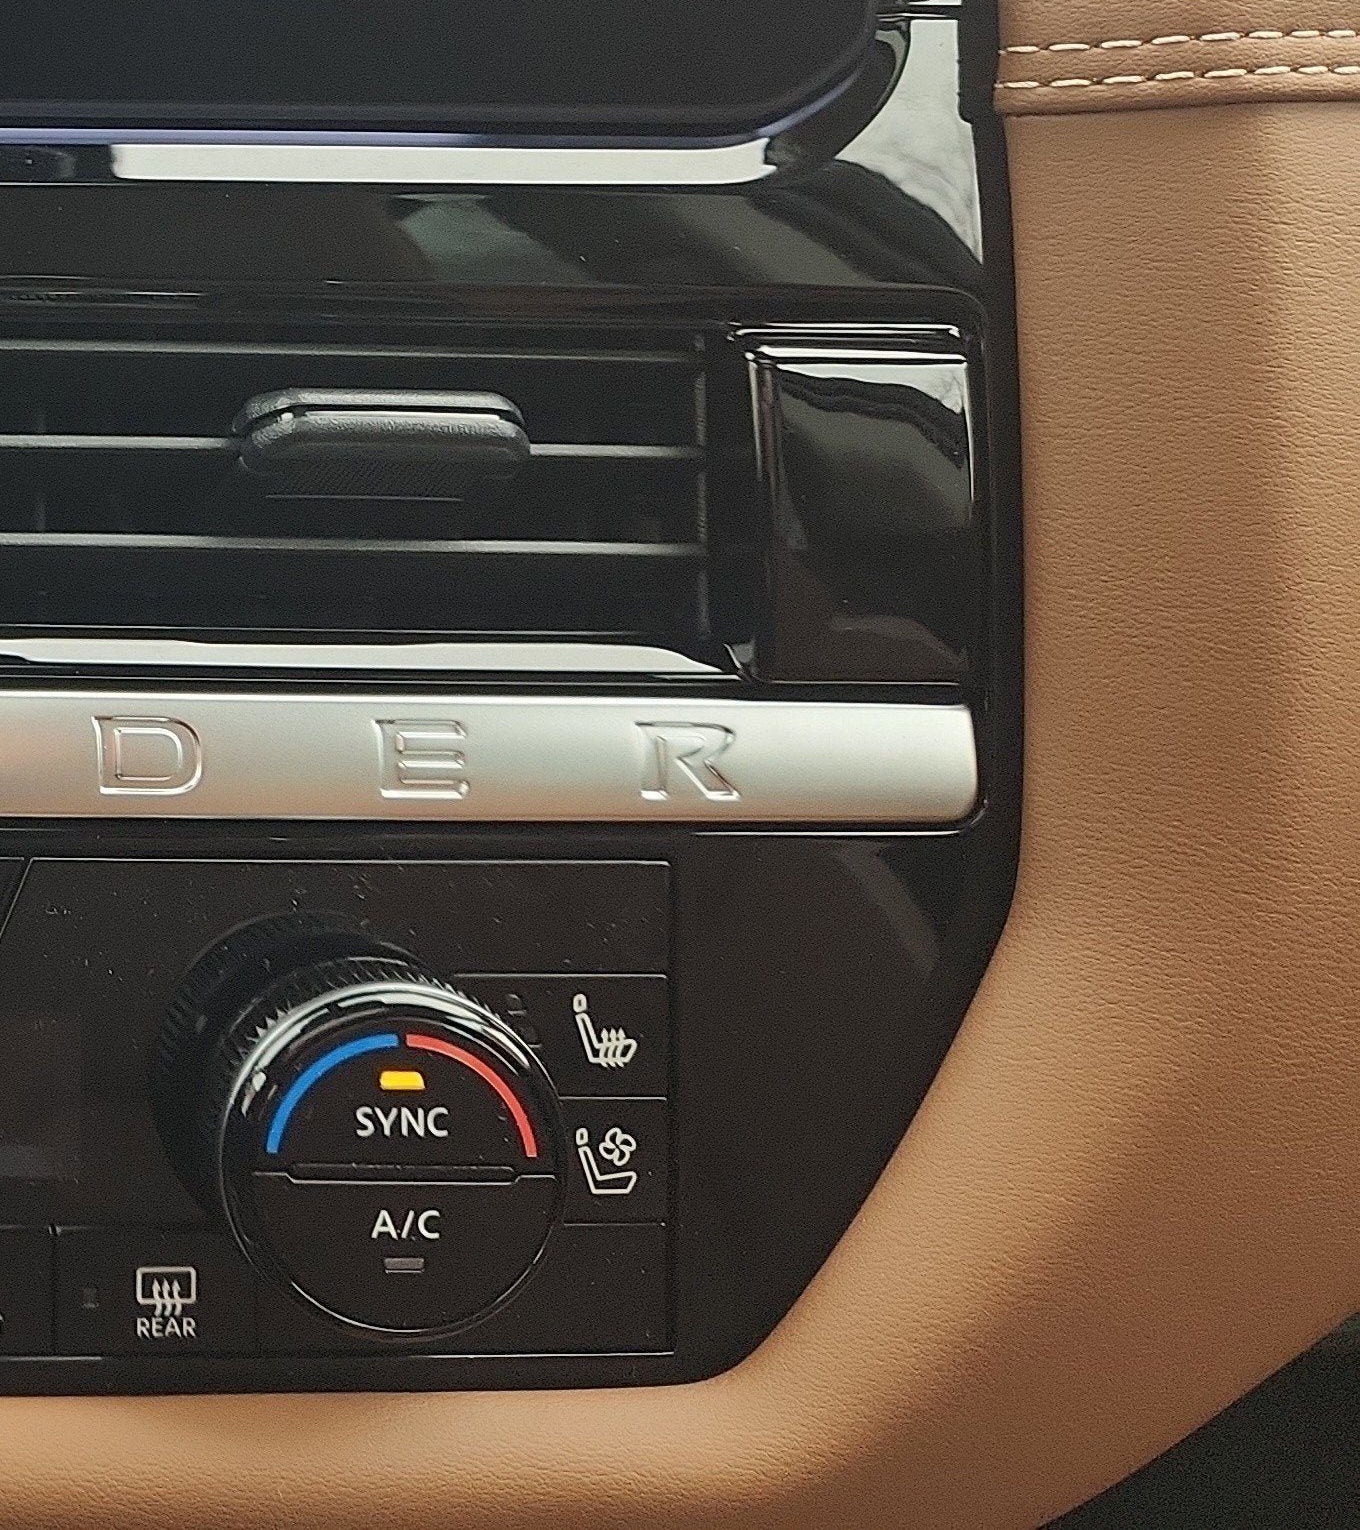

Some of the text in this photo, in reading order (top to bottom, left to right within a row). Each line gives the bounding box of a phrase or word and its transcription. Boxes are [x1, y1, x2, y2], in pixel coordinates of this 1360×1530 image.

[355, 1106, 449, 1138] SYNC
[371, 1209, 440, 1240] A/C
[134, 1315, 197, 1339] REAR
